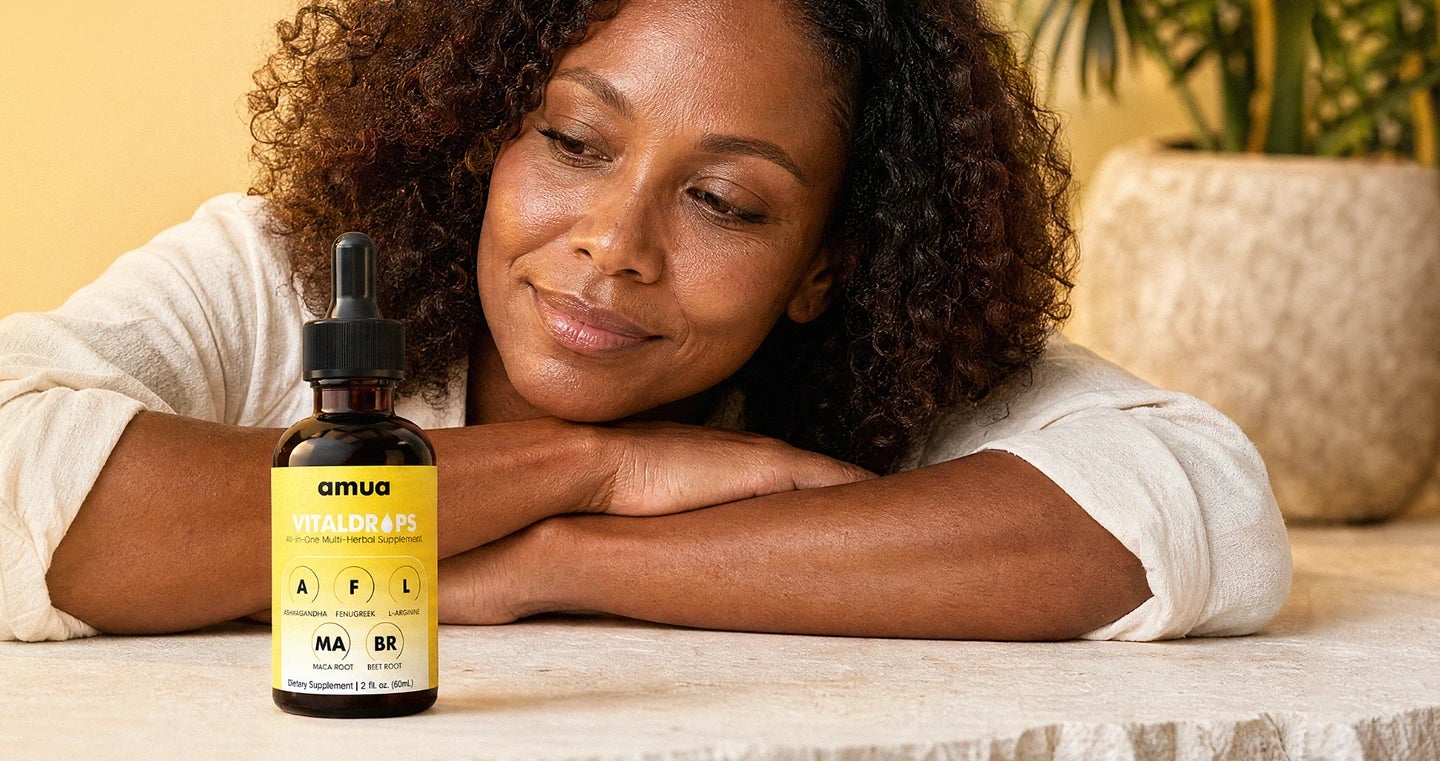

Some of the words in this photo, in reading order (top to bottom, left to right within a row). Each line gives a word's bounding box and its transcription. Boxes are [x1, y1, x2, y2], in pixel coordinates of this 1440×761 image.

[318, 480, 391, 497] amua
[322, 535, 376, 544] Multi-Herbal
[377, 535, 423, 545] Supplement
[297, 579, 308, 594] A
[350, 579, 359, 595] F
[403, 578, 411, 593] L
[283, 609, 328, 617] ASHWAGANDHA
[335, 610, 376, 618] FENUGREEK
[315, 636, 347, 652] MA
[374, 636, 398, 652] BR
[312, 663, 333, 671] MACA
[334, 663, 354, 671] ROOT
[367, 663, 382, 671] BEET
[383, 662, 403, 670] ROOT
[287, 678, 308, 690] Dietary
[308, 680, 354, 691] Supplement
[360, 681, 366, 690] 2
[391, 678, 414, 690] (60mL)
